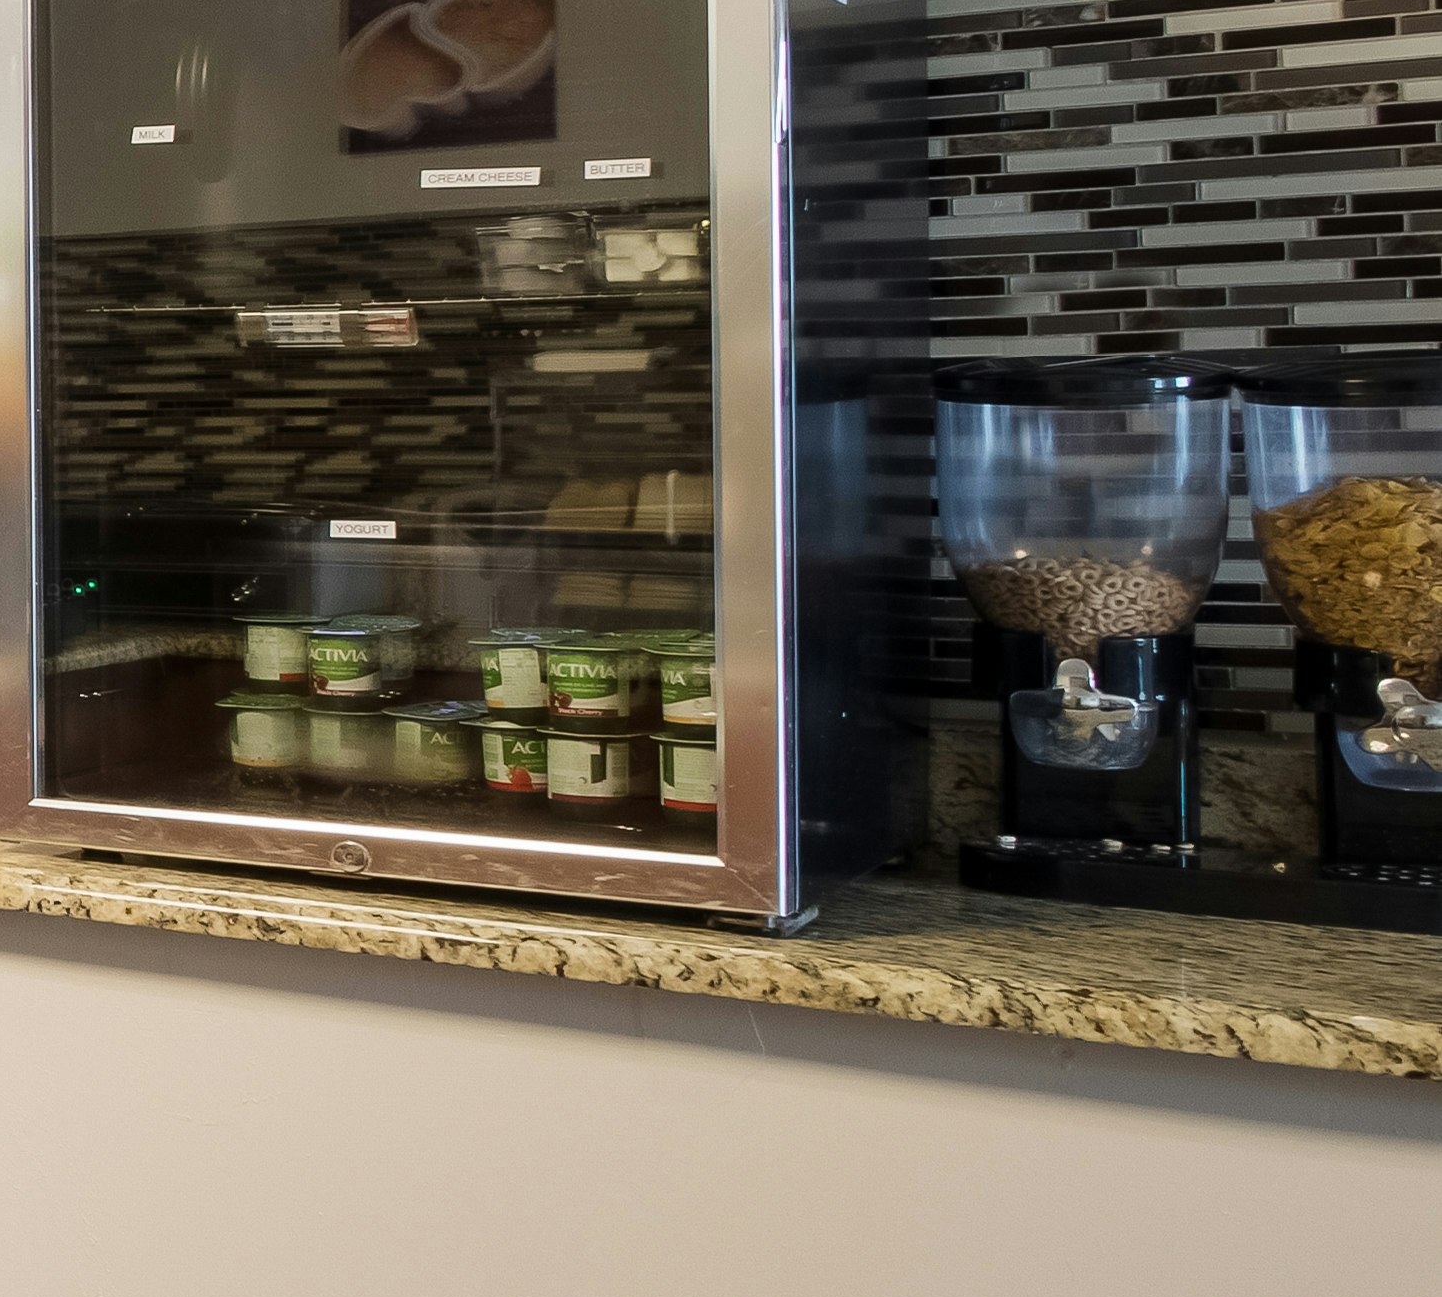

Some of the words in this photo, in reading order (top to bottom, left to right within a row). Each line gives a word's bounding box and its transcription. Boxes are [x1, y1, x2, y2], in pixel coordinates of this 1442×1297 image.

[138, 129, 166, 139] MILK
[590, 163, 645, 174] BUTTER
[428, 173, 475, 184] CREAM
[478, 171, 533, 182] CHEESE
[335, 524, 389, 534] YOGURT
[308, 649, 369, 664] ACTIVIA
[549, 662, 618, 679] ACTIVIA
